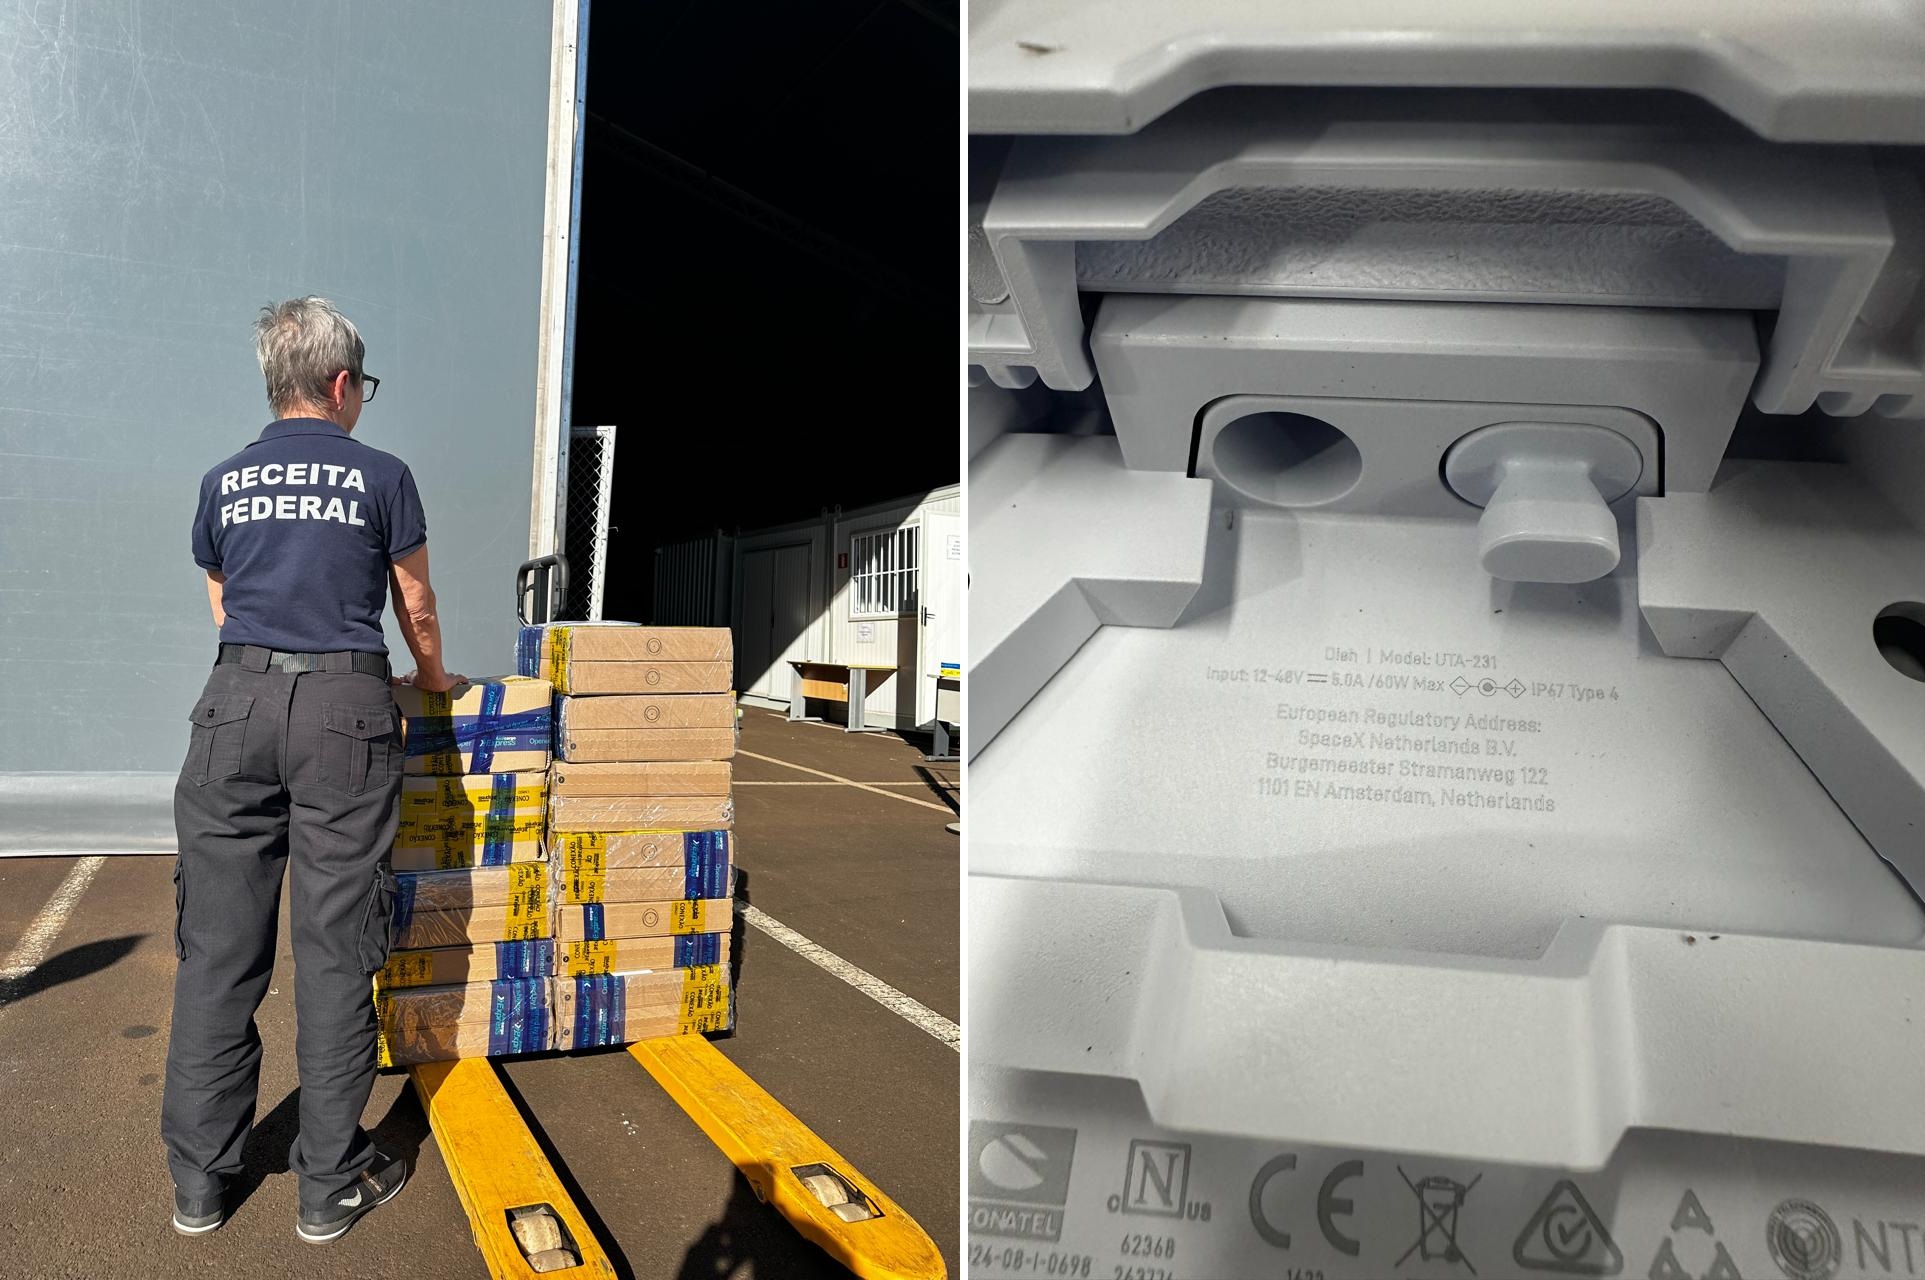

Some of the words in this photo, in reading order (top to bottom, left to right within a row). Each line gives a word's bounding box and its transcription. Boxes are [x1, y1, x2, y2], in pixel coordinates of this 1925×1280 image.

[221, 463, 366, 496] RECEITA
[221, 495, 366, 528] FEDERAL
[1379, 649, 1431, 666] Model:
[1435, 653, 1497, 670] UTA-231
[1206, 667, 1248, 683] Input:
[1413, 676, 1444, 692] Max
[1531, 682, 1564, 698] IP67
[1567, 684, 1605, 702] Type
[1609, 686, 1619, 701] 4
[1276, 703, 1359, 724] European
[1364, 708, 1460, 731] Regulatory
[1464, 713, 1542, 733] Address:
[1298, 728, 1366, 749] SpaceX
[1369, 732, 1480, 755] Netherlands
[1485, 738, 1517, 757] B.V.
[1266, 751, 1395, 775] Burgemeester
[1399, 759, 1515, 786] Stramanweg
[1520, 766, 1549, 785] 122
[1258, 777, 1289, 796] 1101
[1293, 780, 1320, 798] EN
[1323, 782, 1436, 807] Amsterdam,
[1440, 788, 1555, 812] Netherlands
[539, 945, 547, 971] Opened
[688, 991, 696, 1017] CONEXÃO
[707, 983, 715, 1009] CONEXÃO
[495, 1002, 505, 1035] Express
[512, 1029, 522, 1053] Expre
[1249, 1153, 1365, 1257] CE
[1120, 1232, 1176, 1259] 62368
[1852, 1218, 1925, 1275] NT
